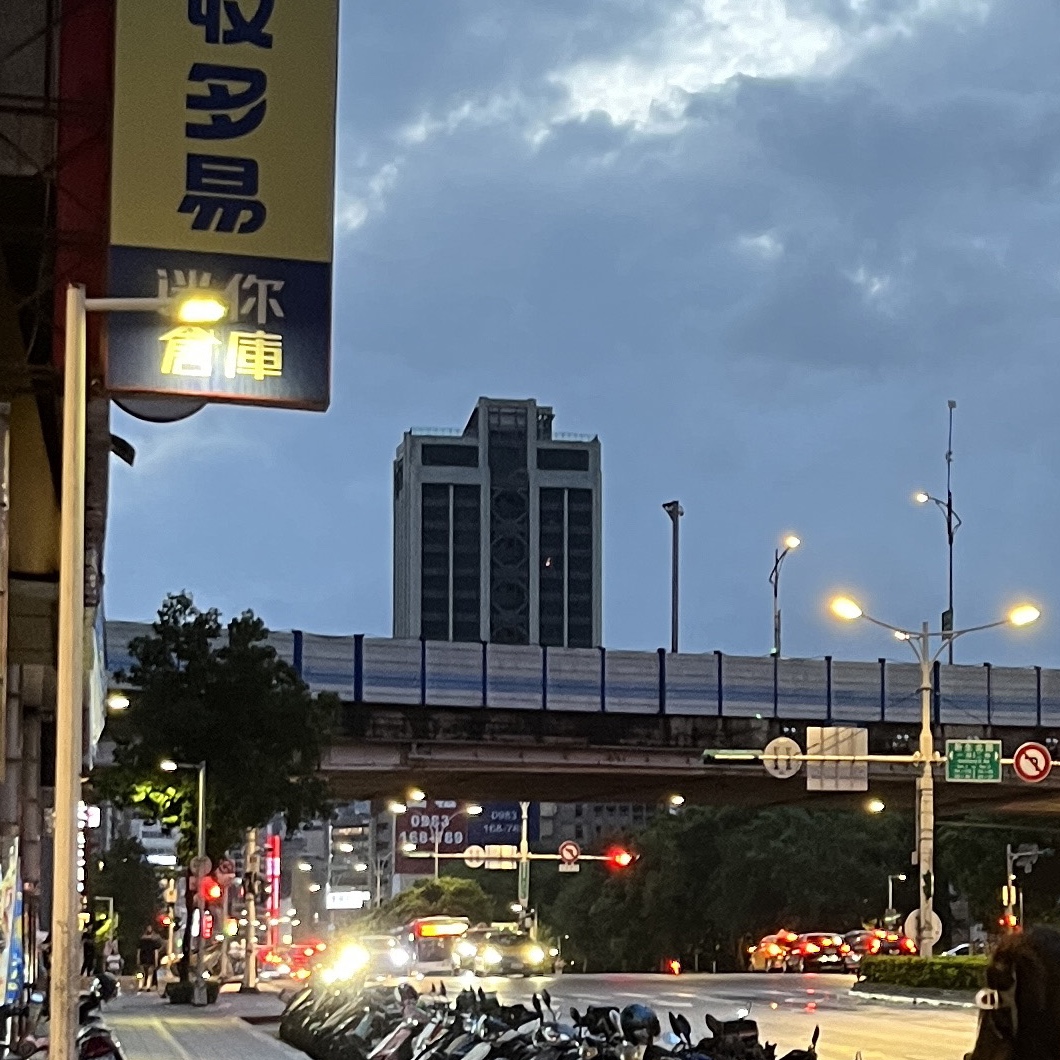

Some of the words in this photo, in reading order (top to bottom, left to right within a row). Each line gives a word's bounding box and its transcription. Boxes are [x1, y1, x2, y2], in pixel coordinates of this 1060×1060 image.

[177, 0, 274, 235] 收多易
[159, 325, 283, 381] 倉庫
